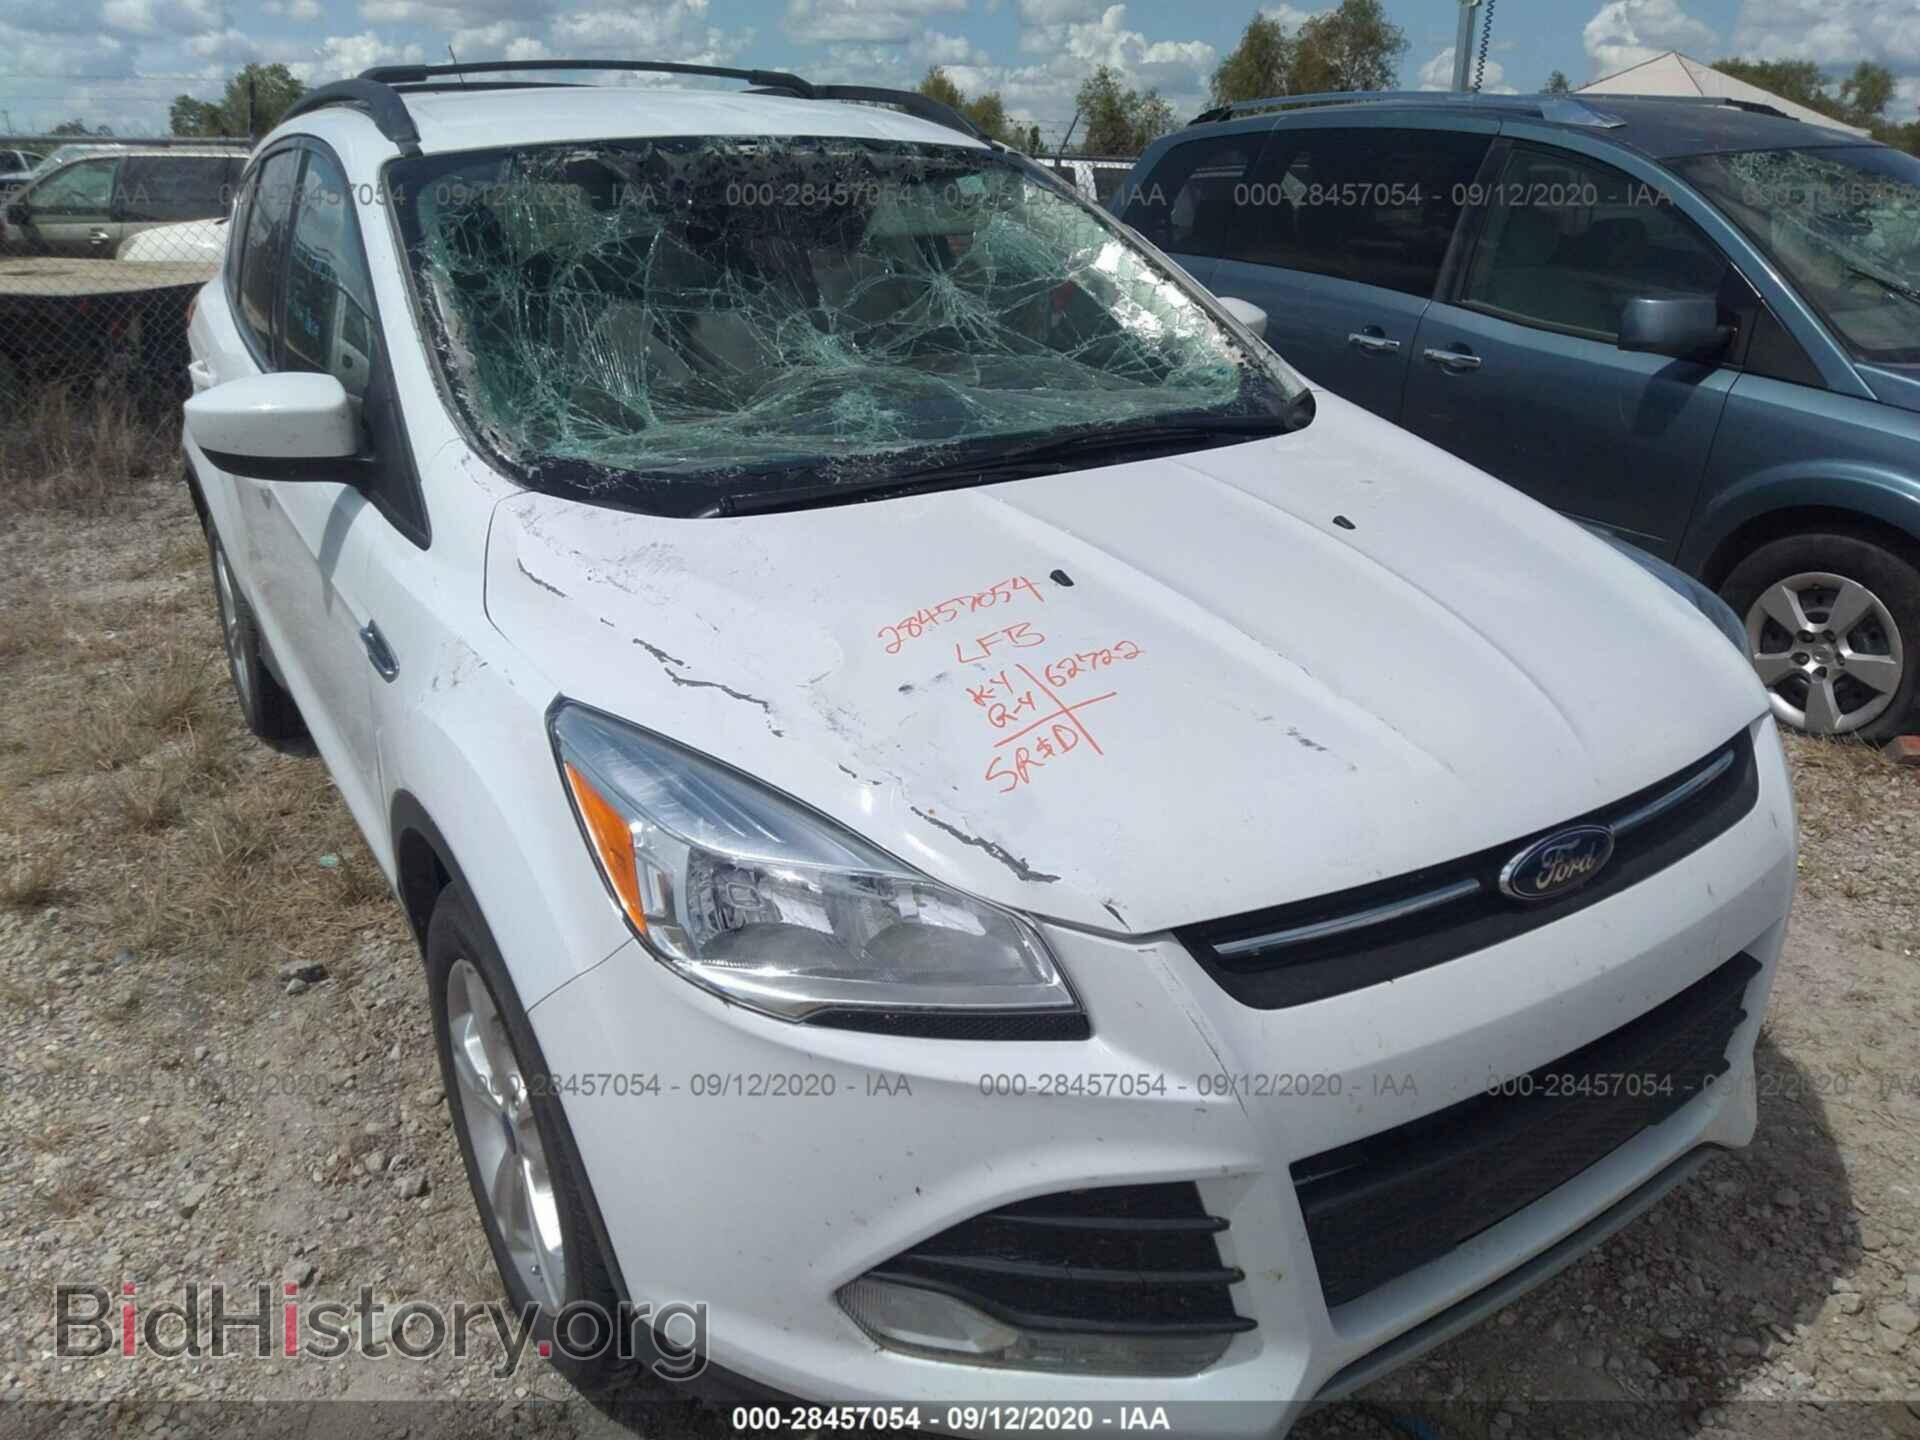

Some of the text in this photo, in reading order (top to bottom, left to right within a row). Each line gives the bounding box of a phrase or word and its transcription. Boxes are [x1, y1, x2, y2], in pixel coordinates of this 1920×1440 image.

[878, 576, 1044, 654] 28457054
[956, 622, 1045, 663] LFB
[1045, 640, 1144, 687] 62722
[1536, 839, 1597, 889] Ford
